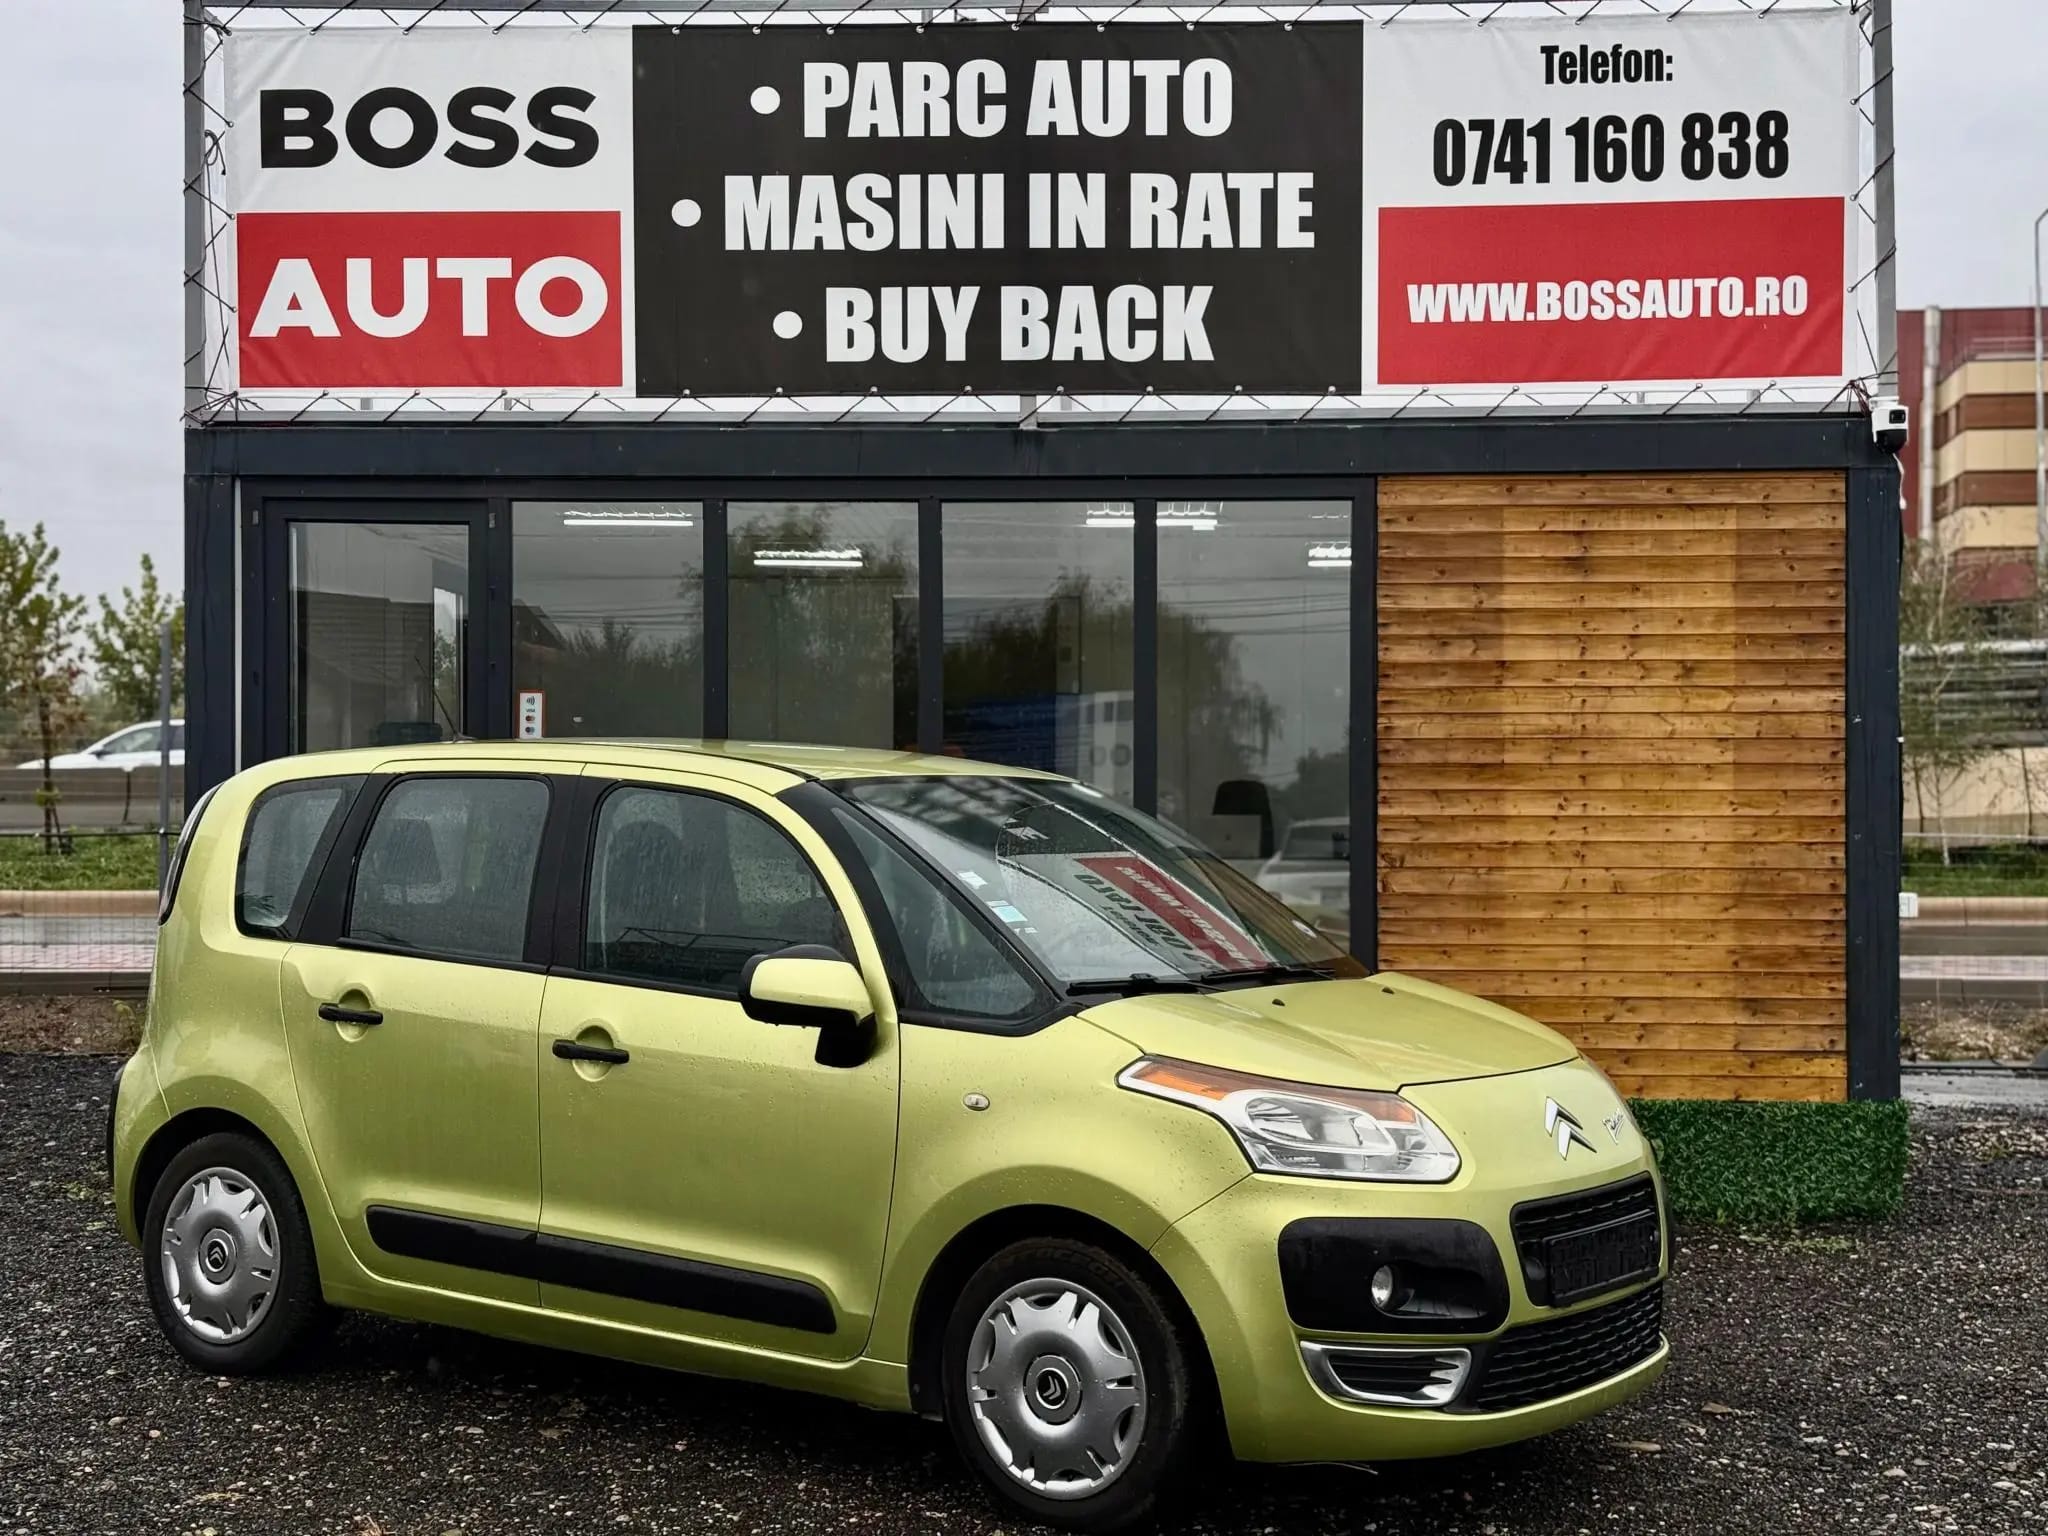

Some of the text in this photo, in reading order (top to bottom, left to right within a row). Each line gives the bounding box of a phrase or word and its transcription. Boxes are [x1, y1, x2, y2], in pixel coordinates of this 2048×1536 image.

[803, 58, 1233, 139] PARC AUTO
[1541, 44, 1673, 85] Telefon:
[260, 86, 600, 169] BOSS
[1433, 110, 1789, 187] 0741 160 838
[724, 172, 1315, 252] MASINI IN RATE
[248, 255, 609, 338] AUTO
[825, 285, 1214, 364] BUY BACK
[1407, 275, 1808, 324] WWW.BOSSAUTO.RO
